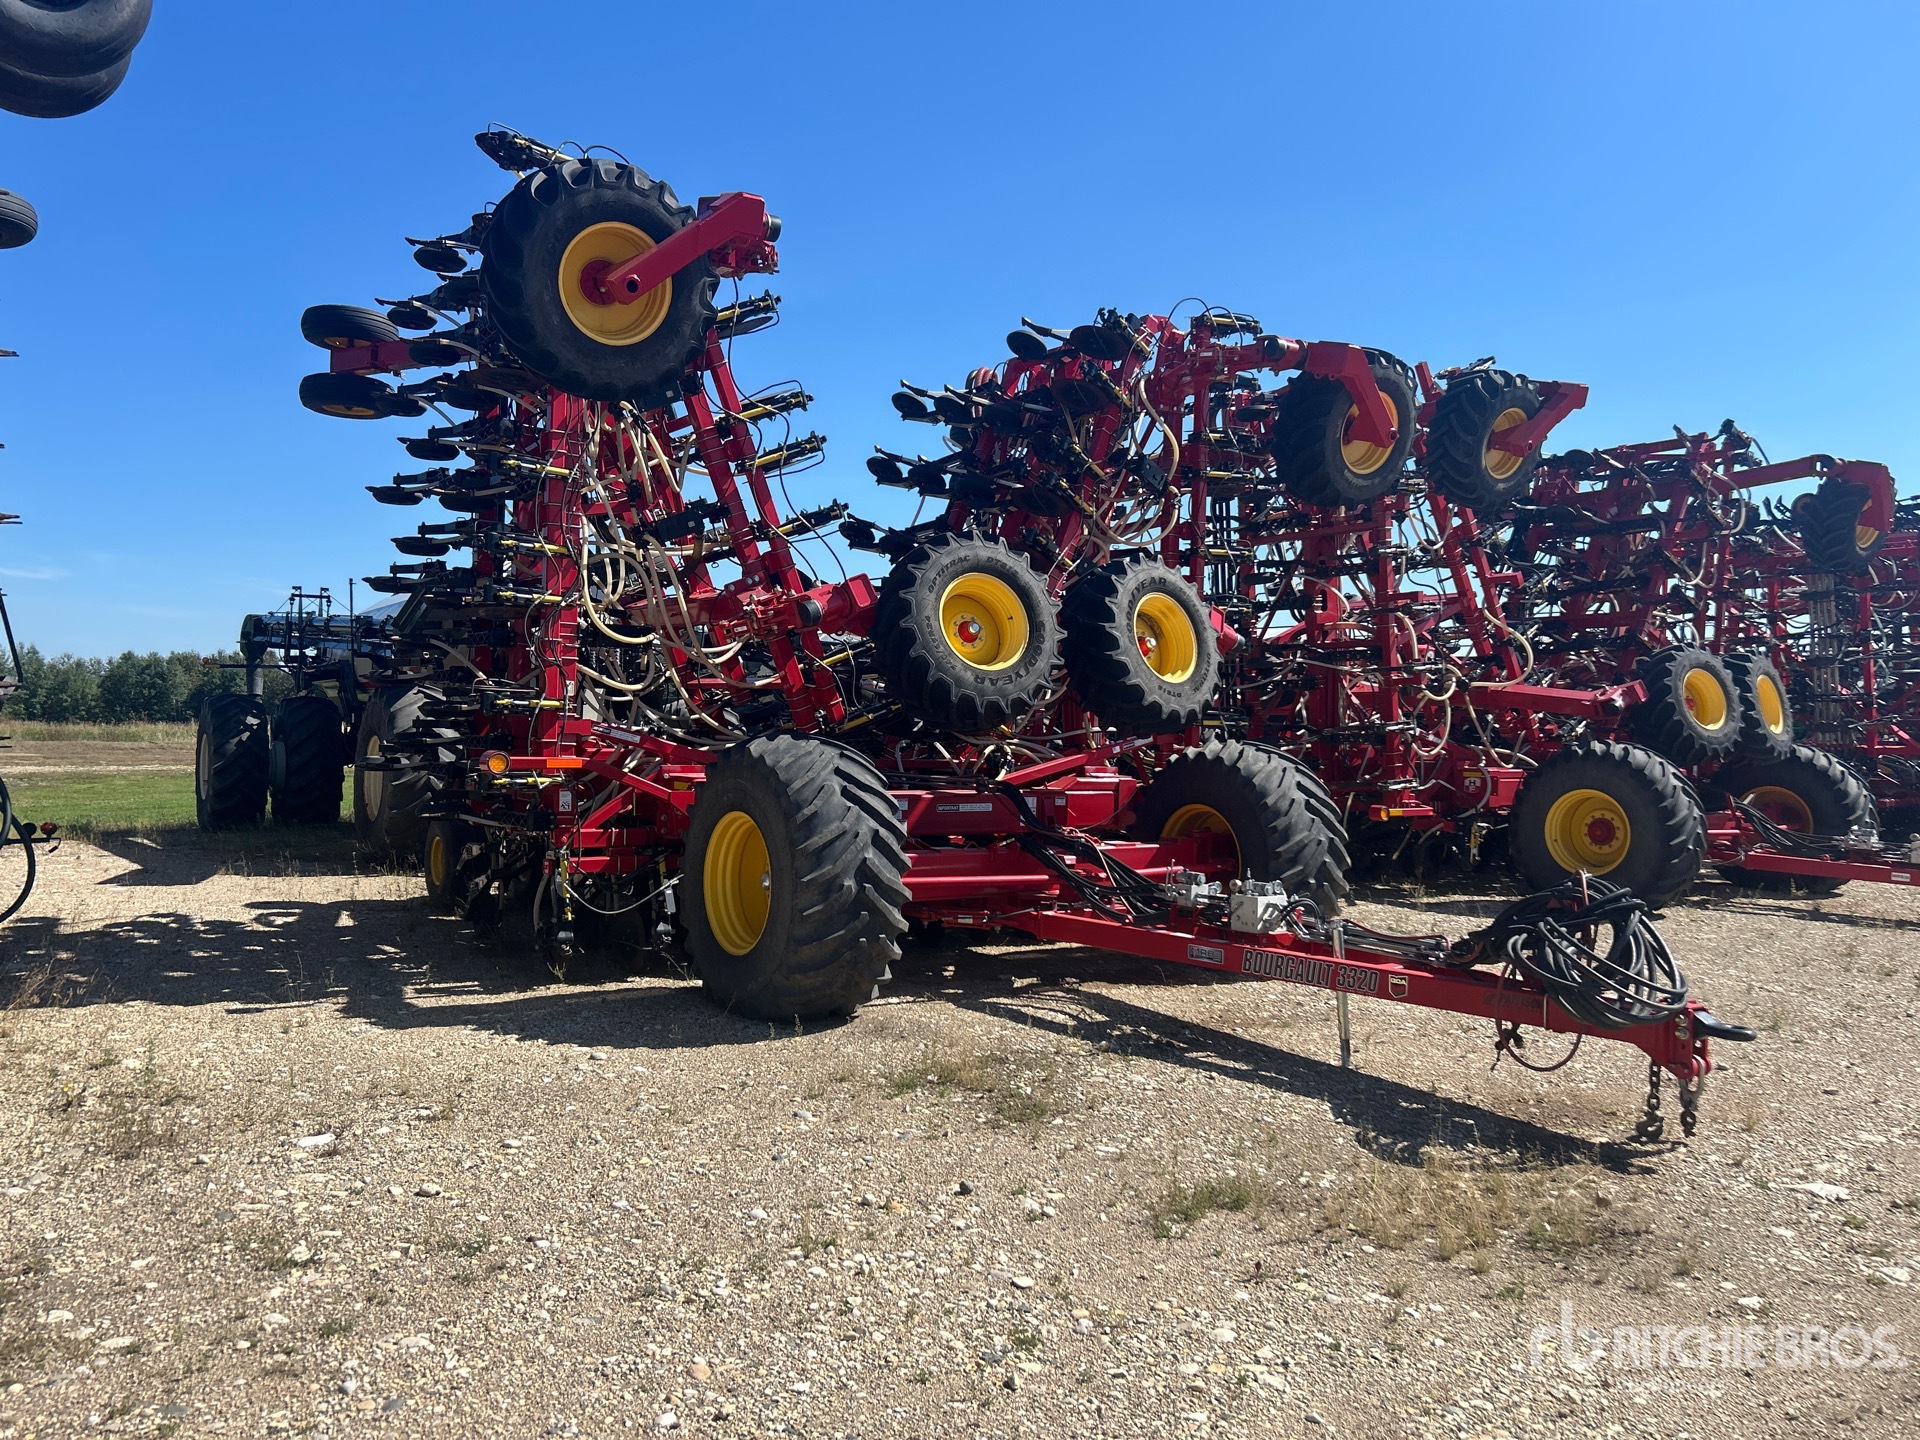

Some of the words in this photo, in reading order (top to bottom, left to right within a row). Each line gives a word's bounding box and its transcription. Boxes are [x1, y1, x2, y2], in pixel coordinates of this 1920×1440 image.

[928, 554, 970, 594] OPTITRAC
[1126, 576, 1168, 646] GOODYEAR
[973, 620, 1046, 686] GOODYEAR
[1242, 949, 1334, 988] BOURGAULT
[1336, 965, 1379, 993] 3320
